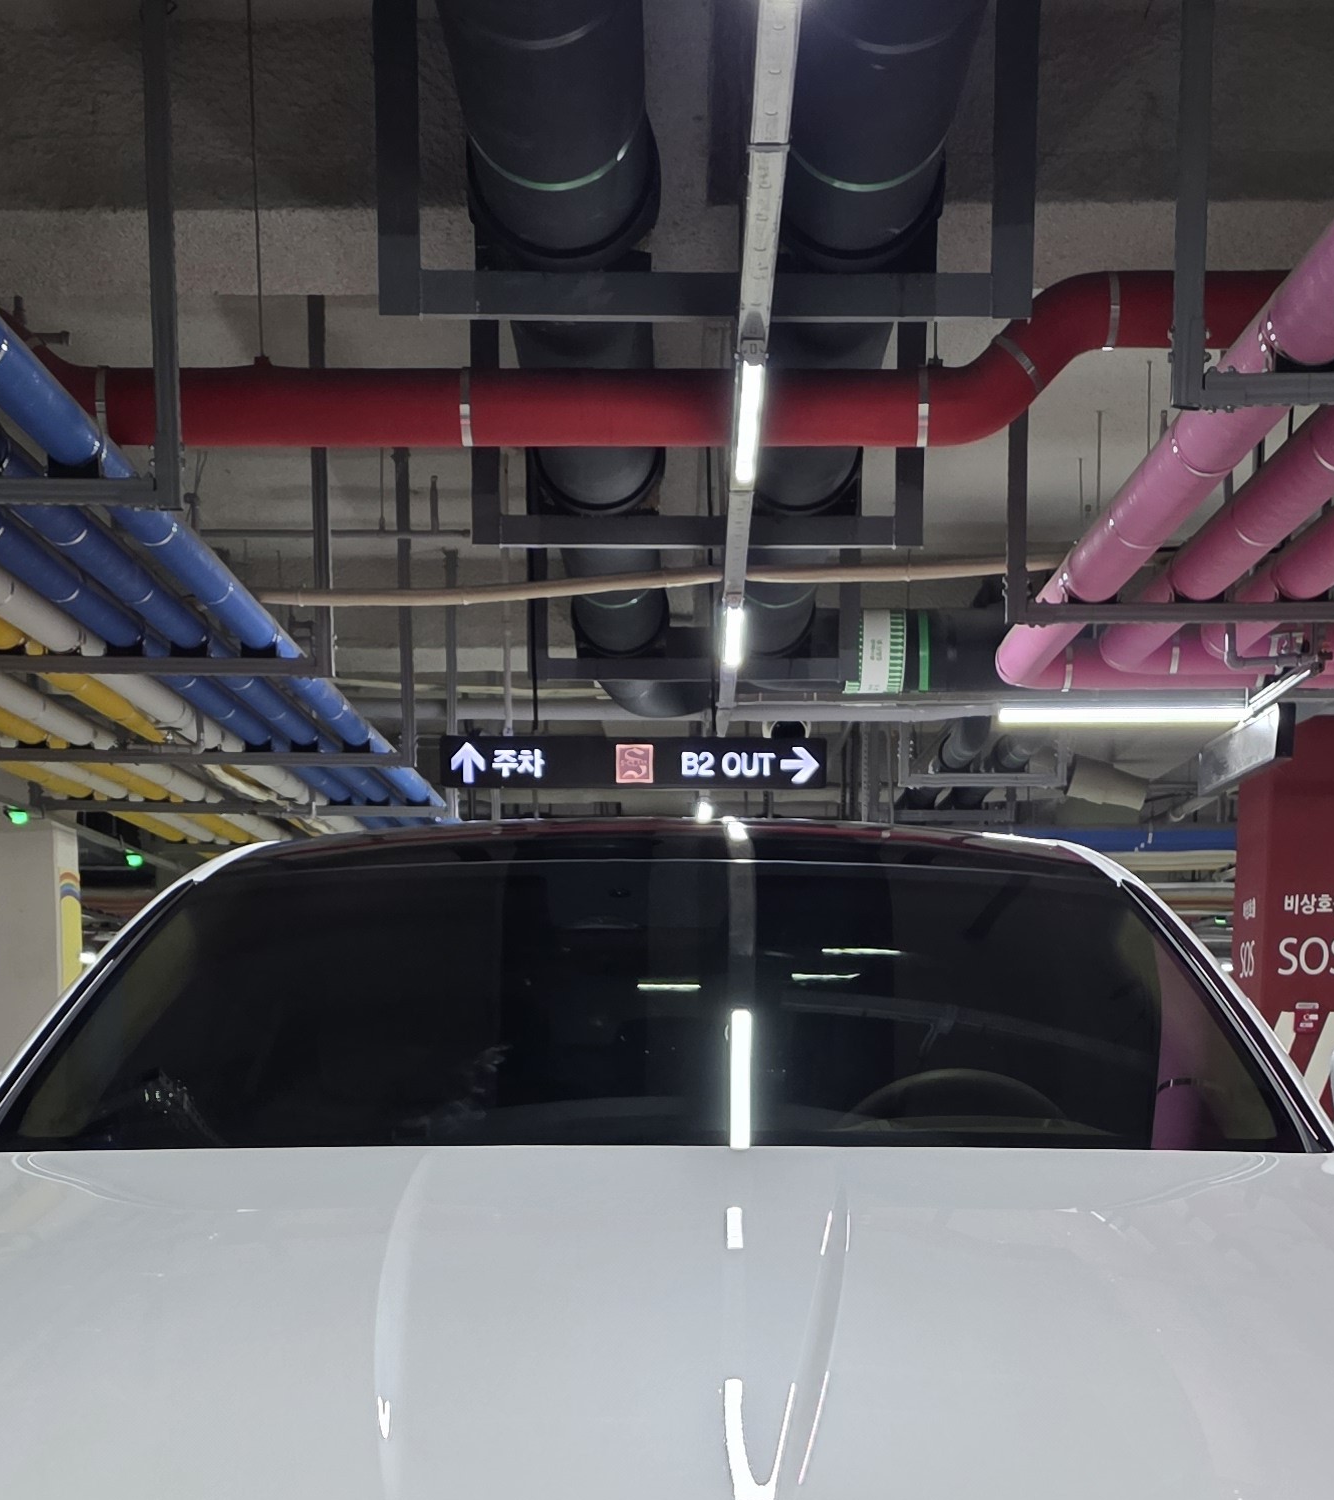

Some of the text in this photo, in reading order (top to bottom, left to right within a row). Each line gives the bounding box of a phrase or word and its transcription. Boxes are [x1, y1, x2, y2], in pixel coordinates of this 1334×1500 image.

[491, 748, 546, 779] 주차
[681, 751, 777, 778] B2 OUT
